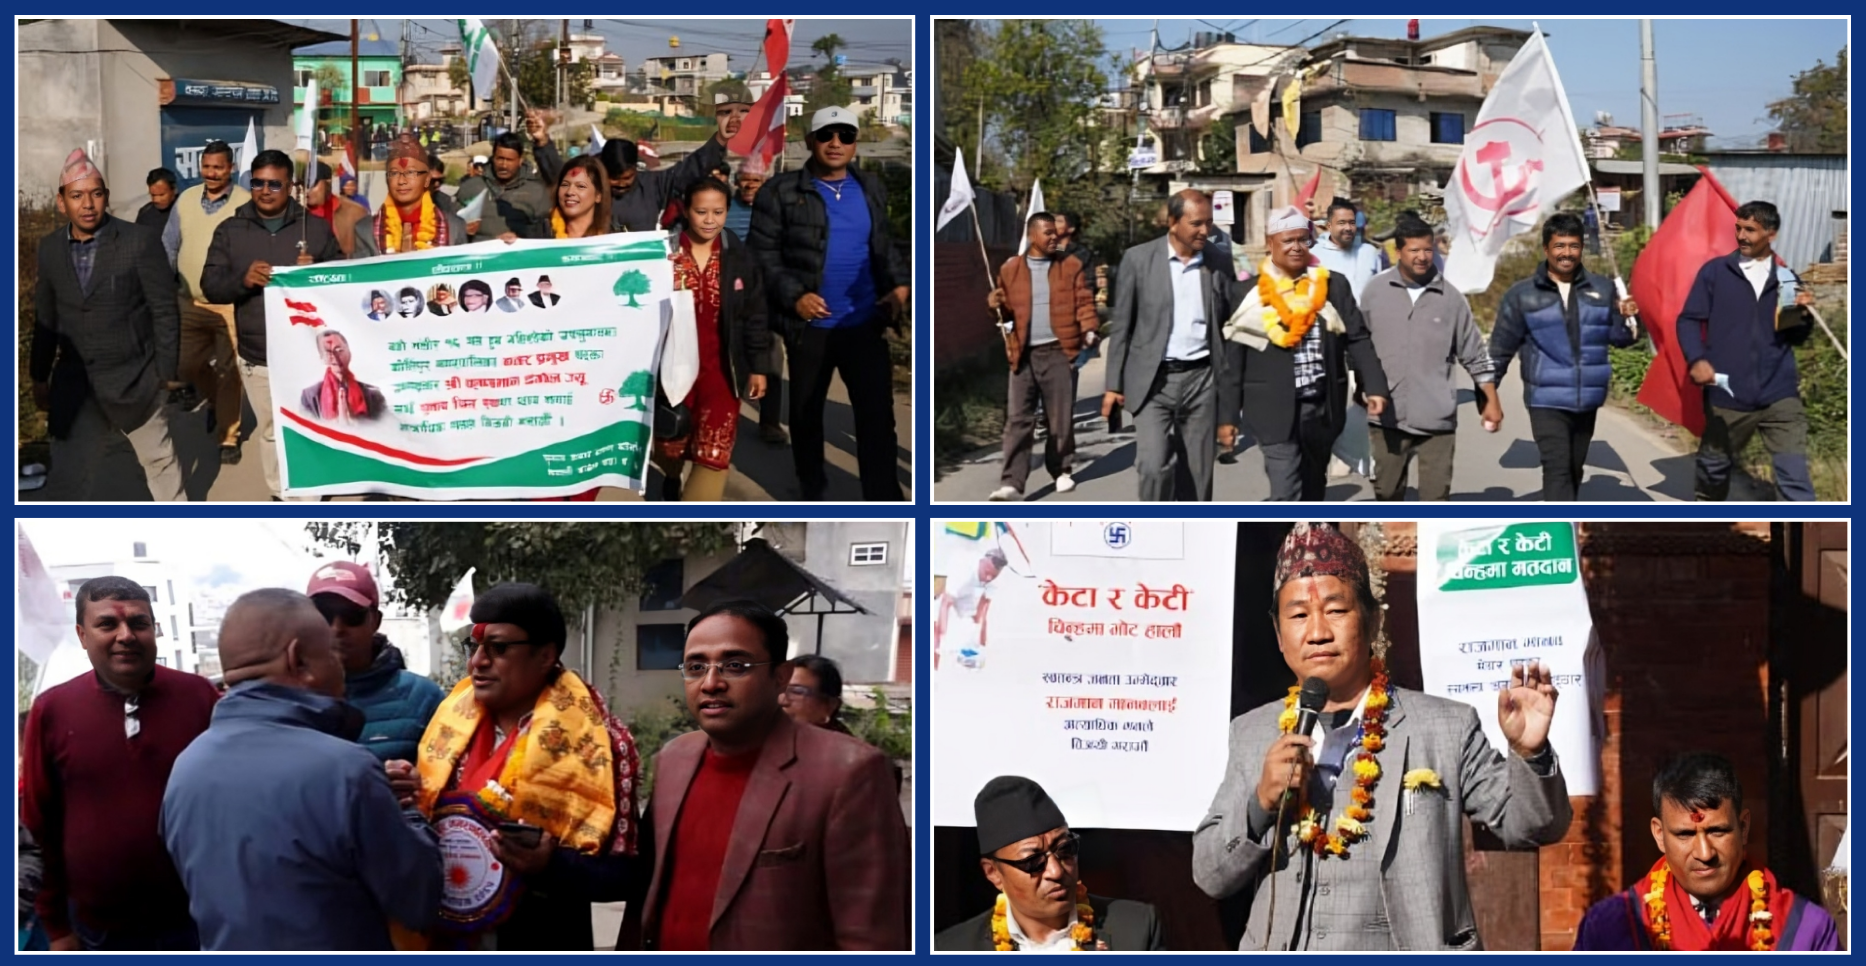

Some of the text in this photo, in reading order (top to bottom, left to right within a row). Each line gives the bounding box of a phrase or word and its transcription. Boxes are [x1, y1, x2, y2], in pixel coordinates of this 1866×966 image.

[1498, 538, 1510, 555] र
[1515, 531, 1552, 552] केटी
[1512, 558, 1572, 577] मतदान
[1107, 589, 1126, 610] र
